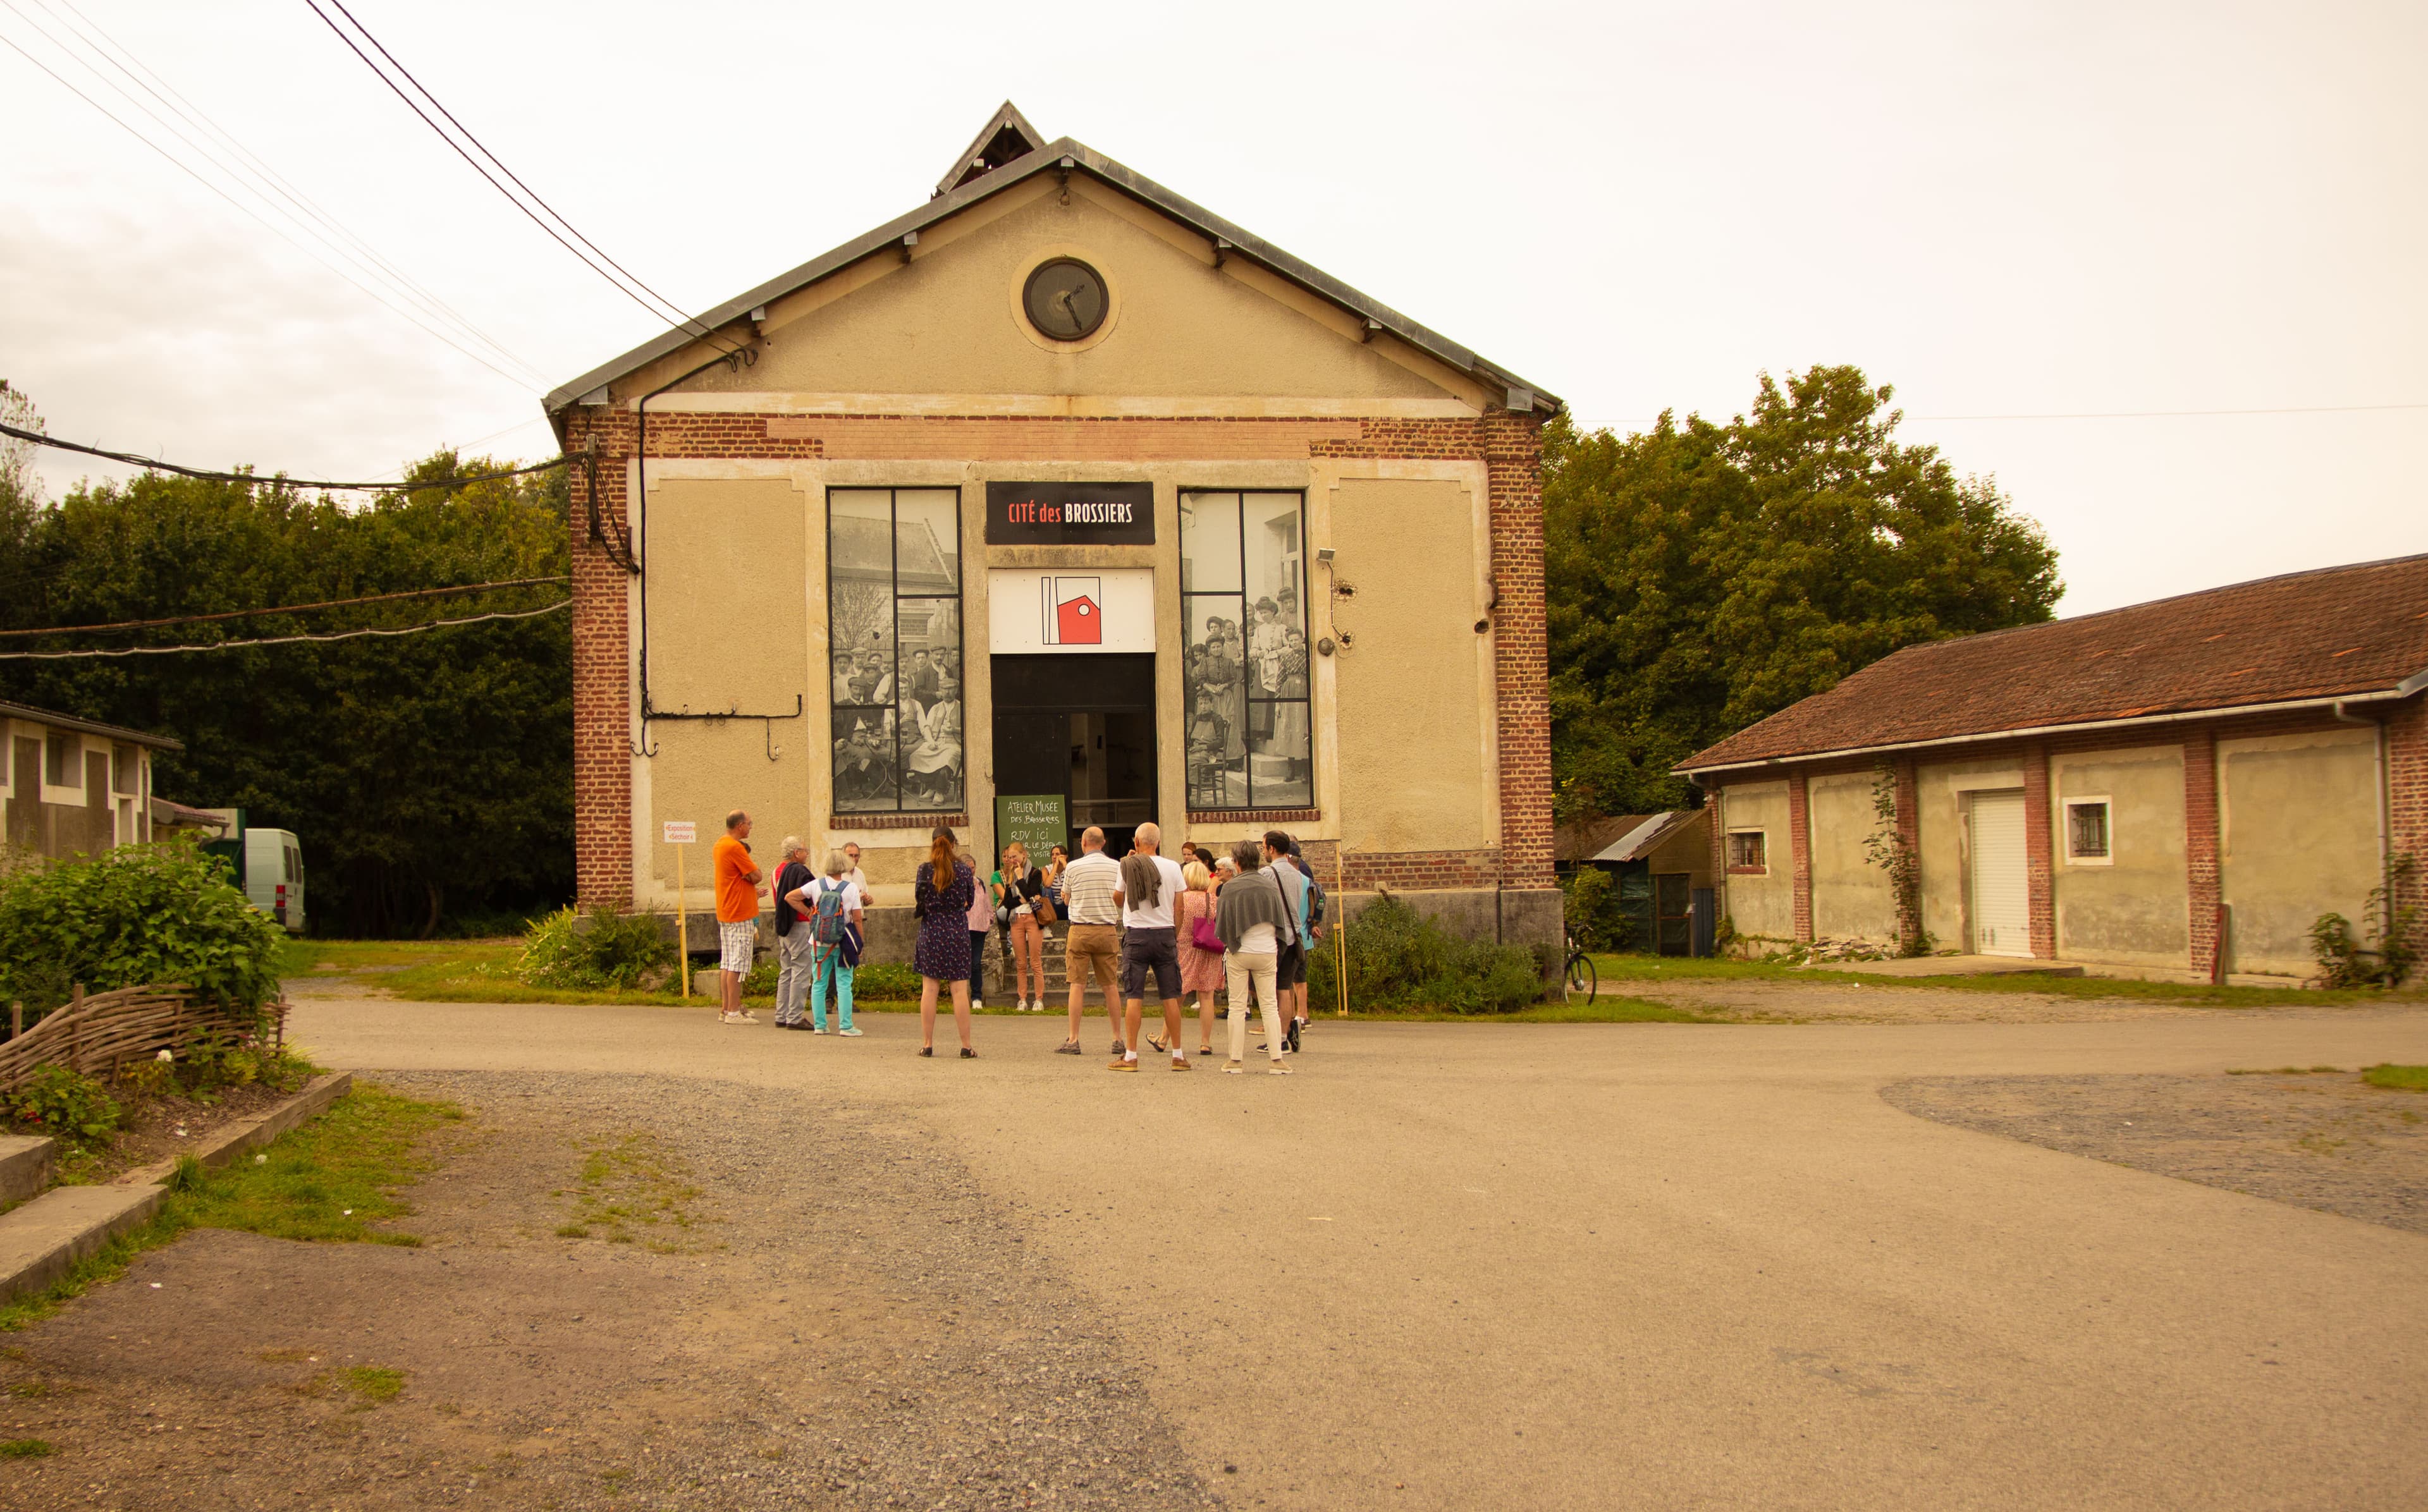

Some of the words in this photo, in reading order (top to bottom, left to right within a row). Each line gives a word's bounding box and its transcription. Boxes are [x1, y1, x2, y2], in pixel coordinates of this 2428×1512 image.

[1009, 500, 1035, 523] CITÉ
[1039, 503, 1060, 523] des
[1065, 503, 1132, 523] BROSSIERS
[1008, 800, 1035, 814] ATELIER
[1035, 800, 1058, 815] MUSÉE
[1011, 831, 1031, 841] RDV
